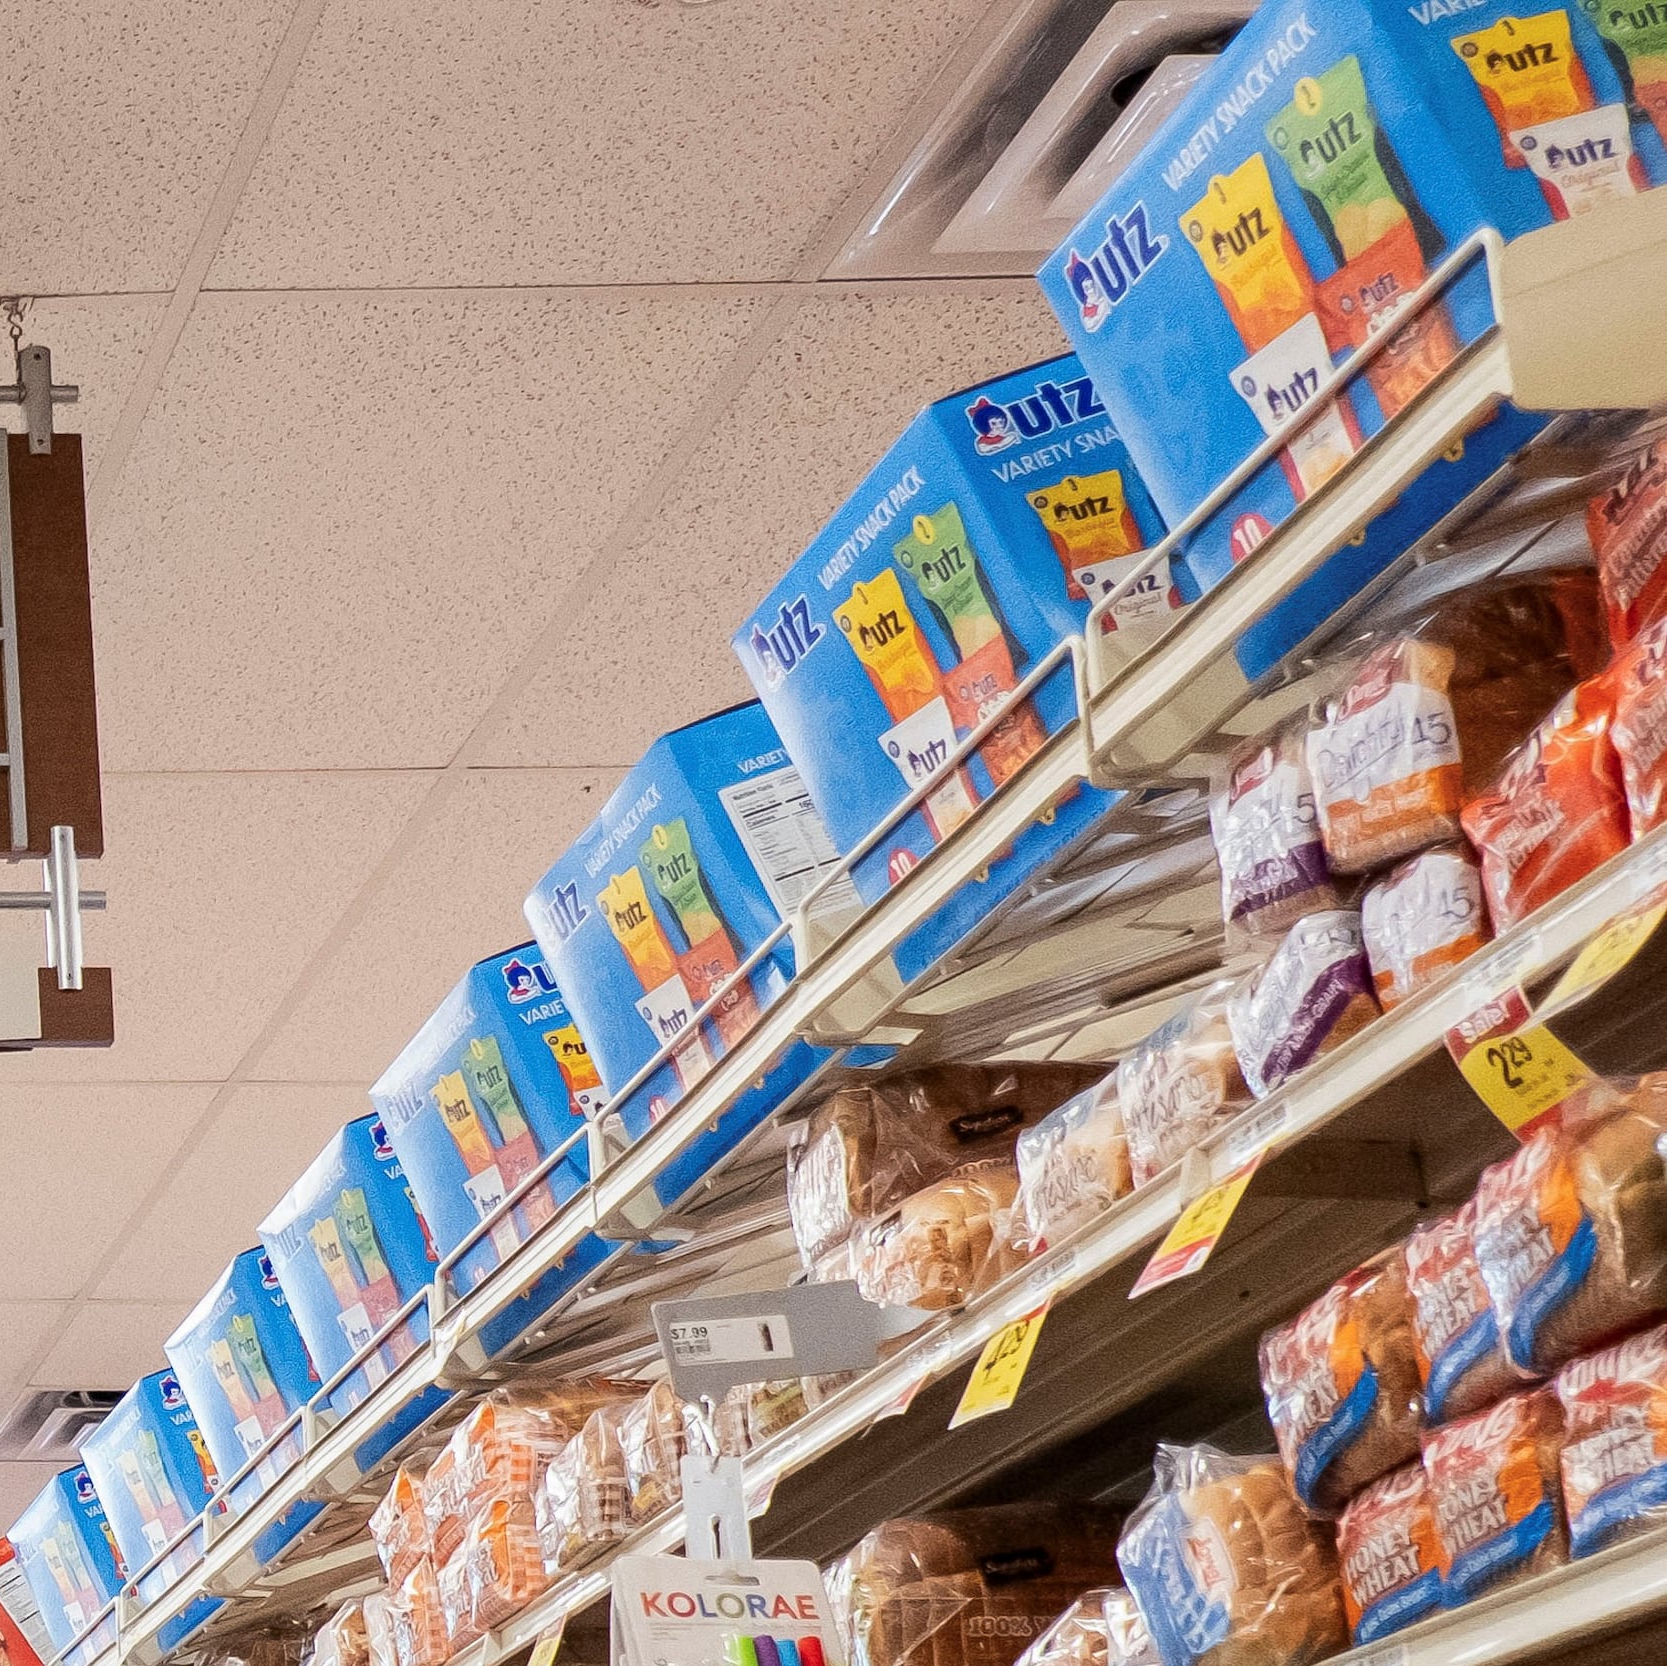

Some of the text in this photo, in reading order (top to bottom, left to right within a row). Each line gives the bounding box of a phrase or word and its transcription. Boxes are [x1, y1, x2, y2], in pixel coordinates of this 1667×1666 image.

[1162, 13, 1319, 192] VARIETY SNACK PACK
[990, 441, 1075, 484] VARIETY
[890, 466, 926, 513] PACK
[640, 1591, 821, 1621] KOLORAE
